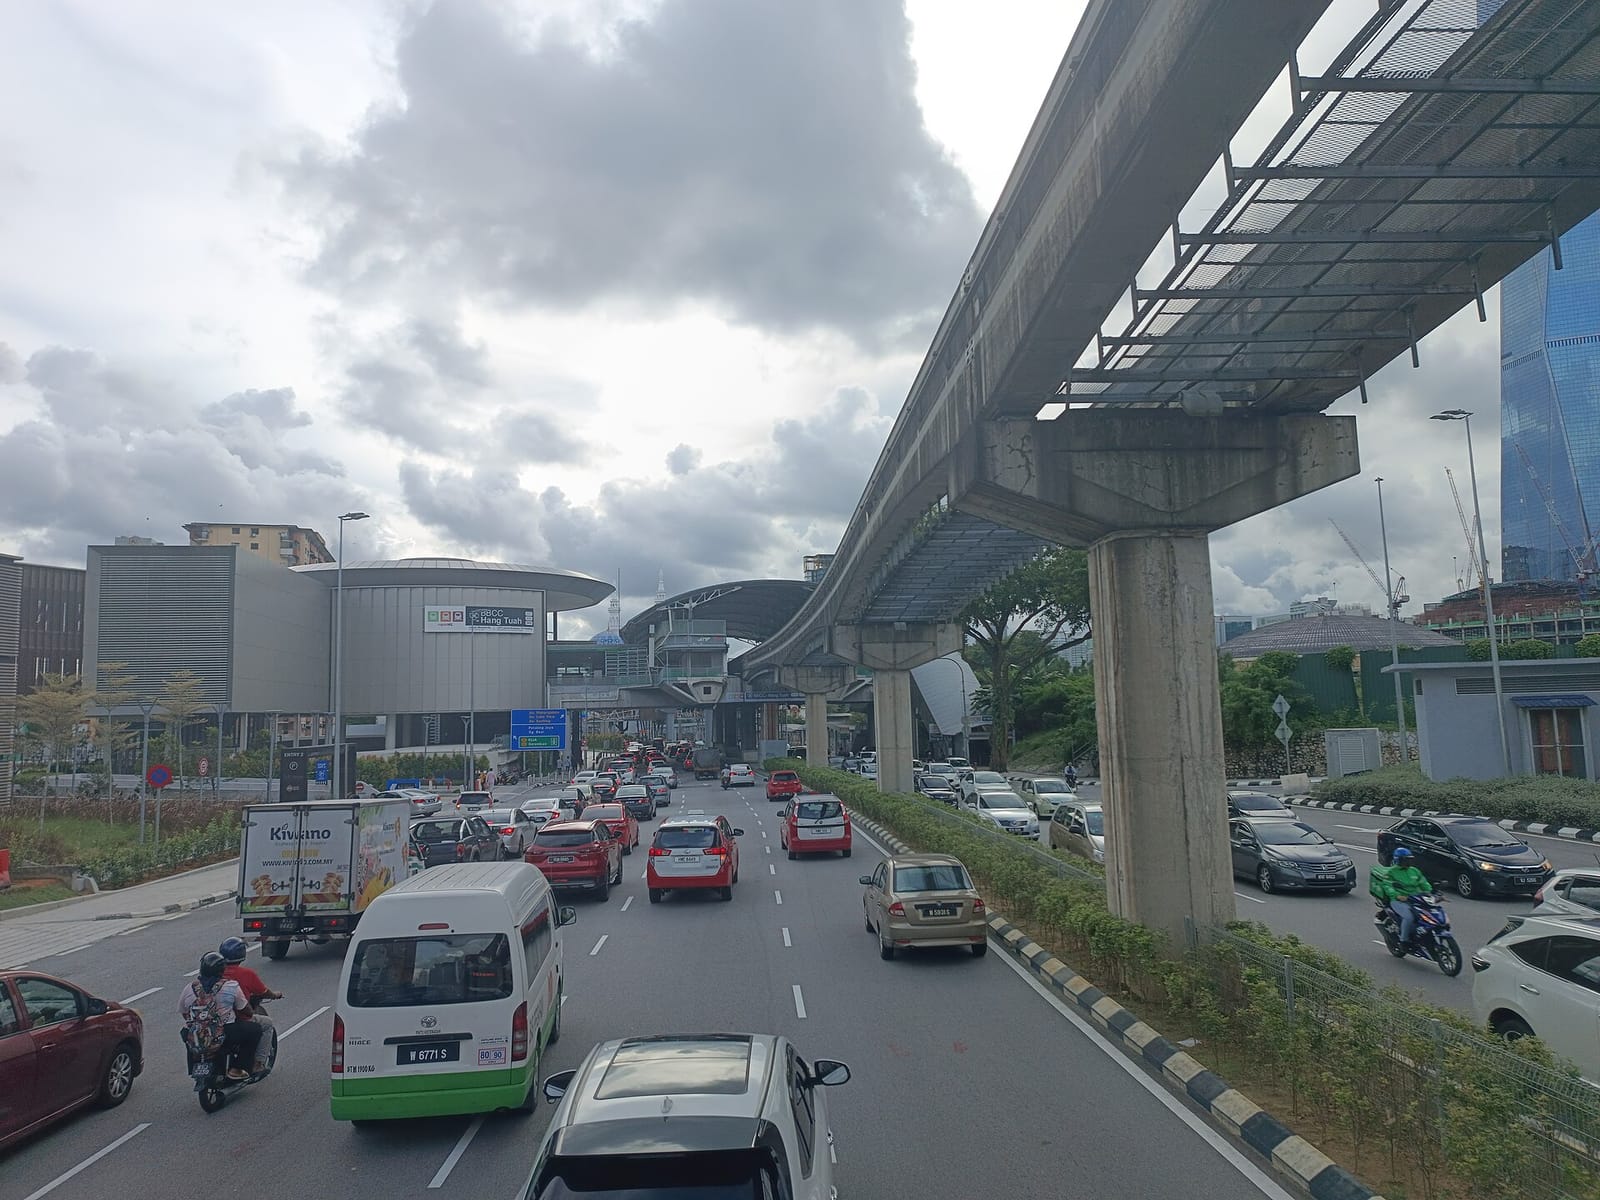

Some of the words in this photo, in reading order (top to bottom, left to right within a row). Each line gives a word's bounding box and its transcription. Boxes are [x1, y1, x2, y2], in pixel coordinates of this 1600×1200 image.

[480, 616, 502, 625] Hang
[504, 617, 522, 625] Tuah
[270, 824, 331, 841] Kiwano
[409, 1051, 416, 1061] W
[419, 1049, 438, 1061] 6771
[441, 1049, 447, 1059] S
[480, 1051, 490, 1059] 80
[493, 1051, 502, 1059] 90
